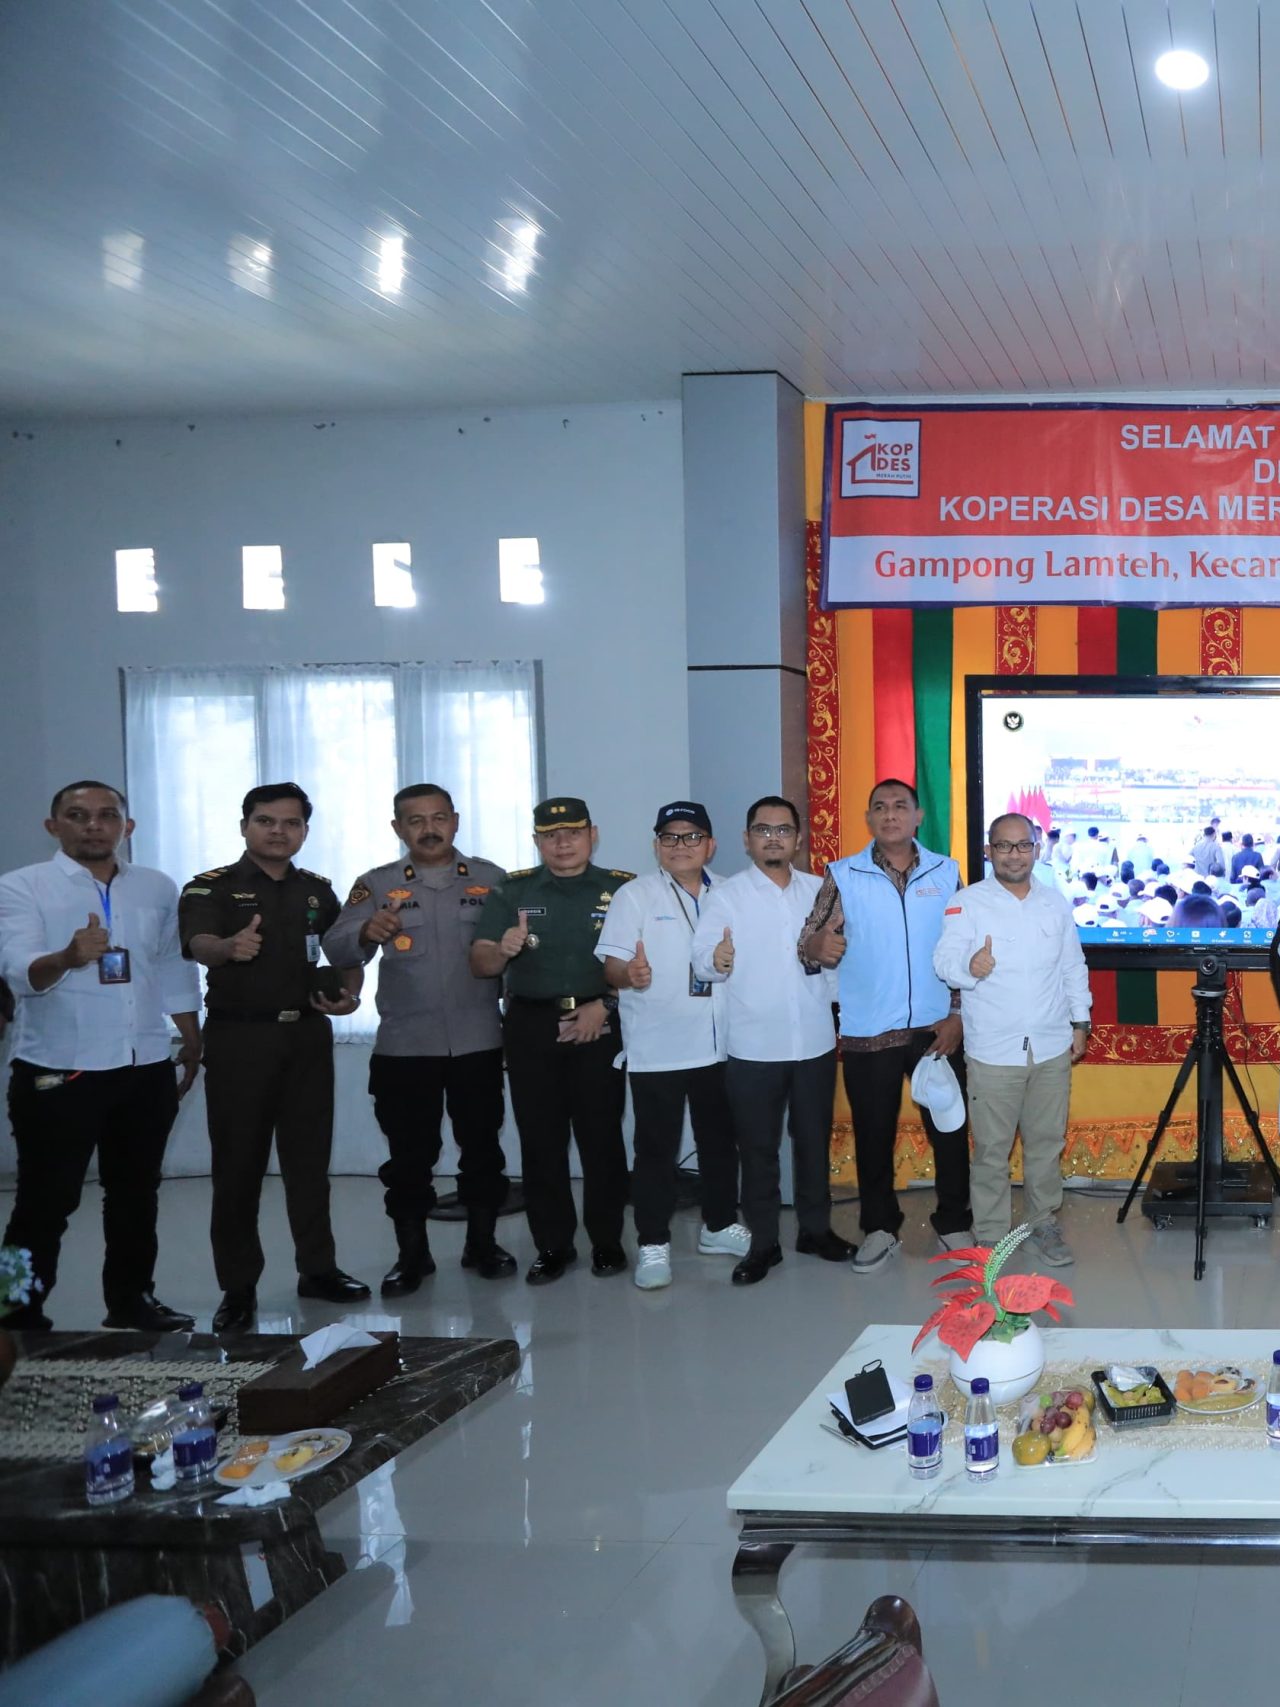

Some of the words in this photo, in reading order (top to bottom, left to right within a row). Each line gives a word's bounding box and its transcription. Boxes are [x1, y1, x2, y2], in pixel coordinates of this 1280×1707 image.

[877, 443, 913, 455] KOP
[1120, 424, 1275, 450] SELAMAT
[877, 458, 911, 471] DES
[940, 495, 1108, 521] KOPERASI
[1119, 496, 1209, 522] DESA
[874, 549, 1035, 584] Gampong
[1045, 550, 1178, 581] Lamteh,
